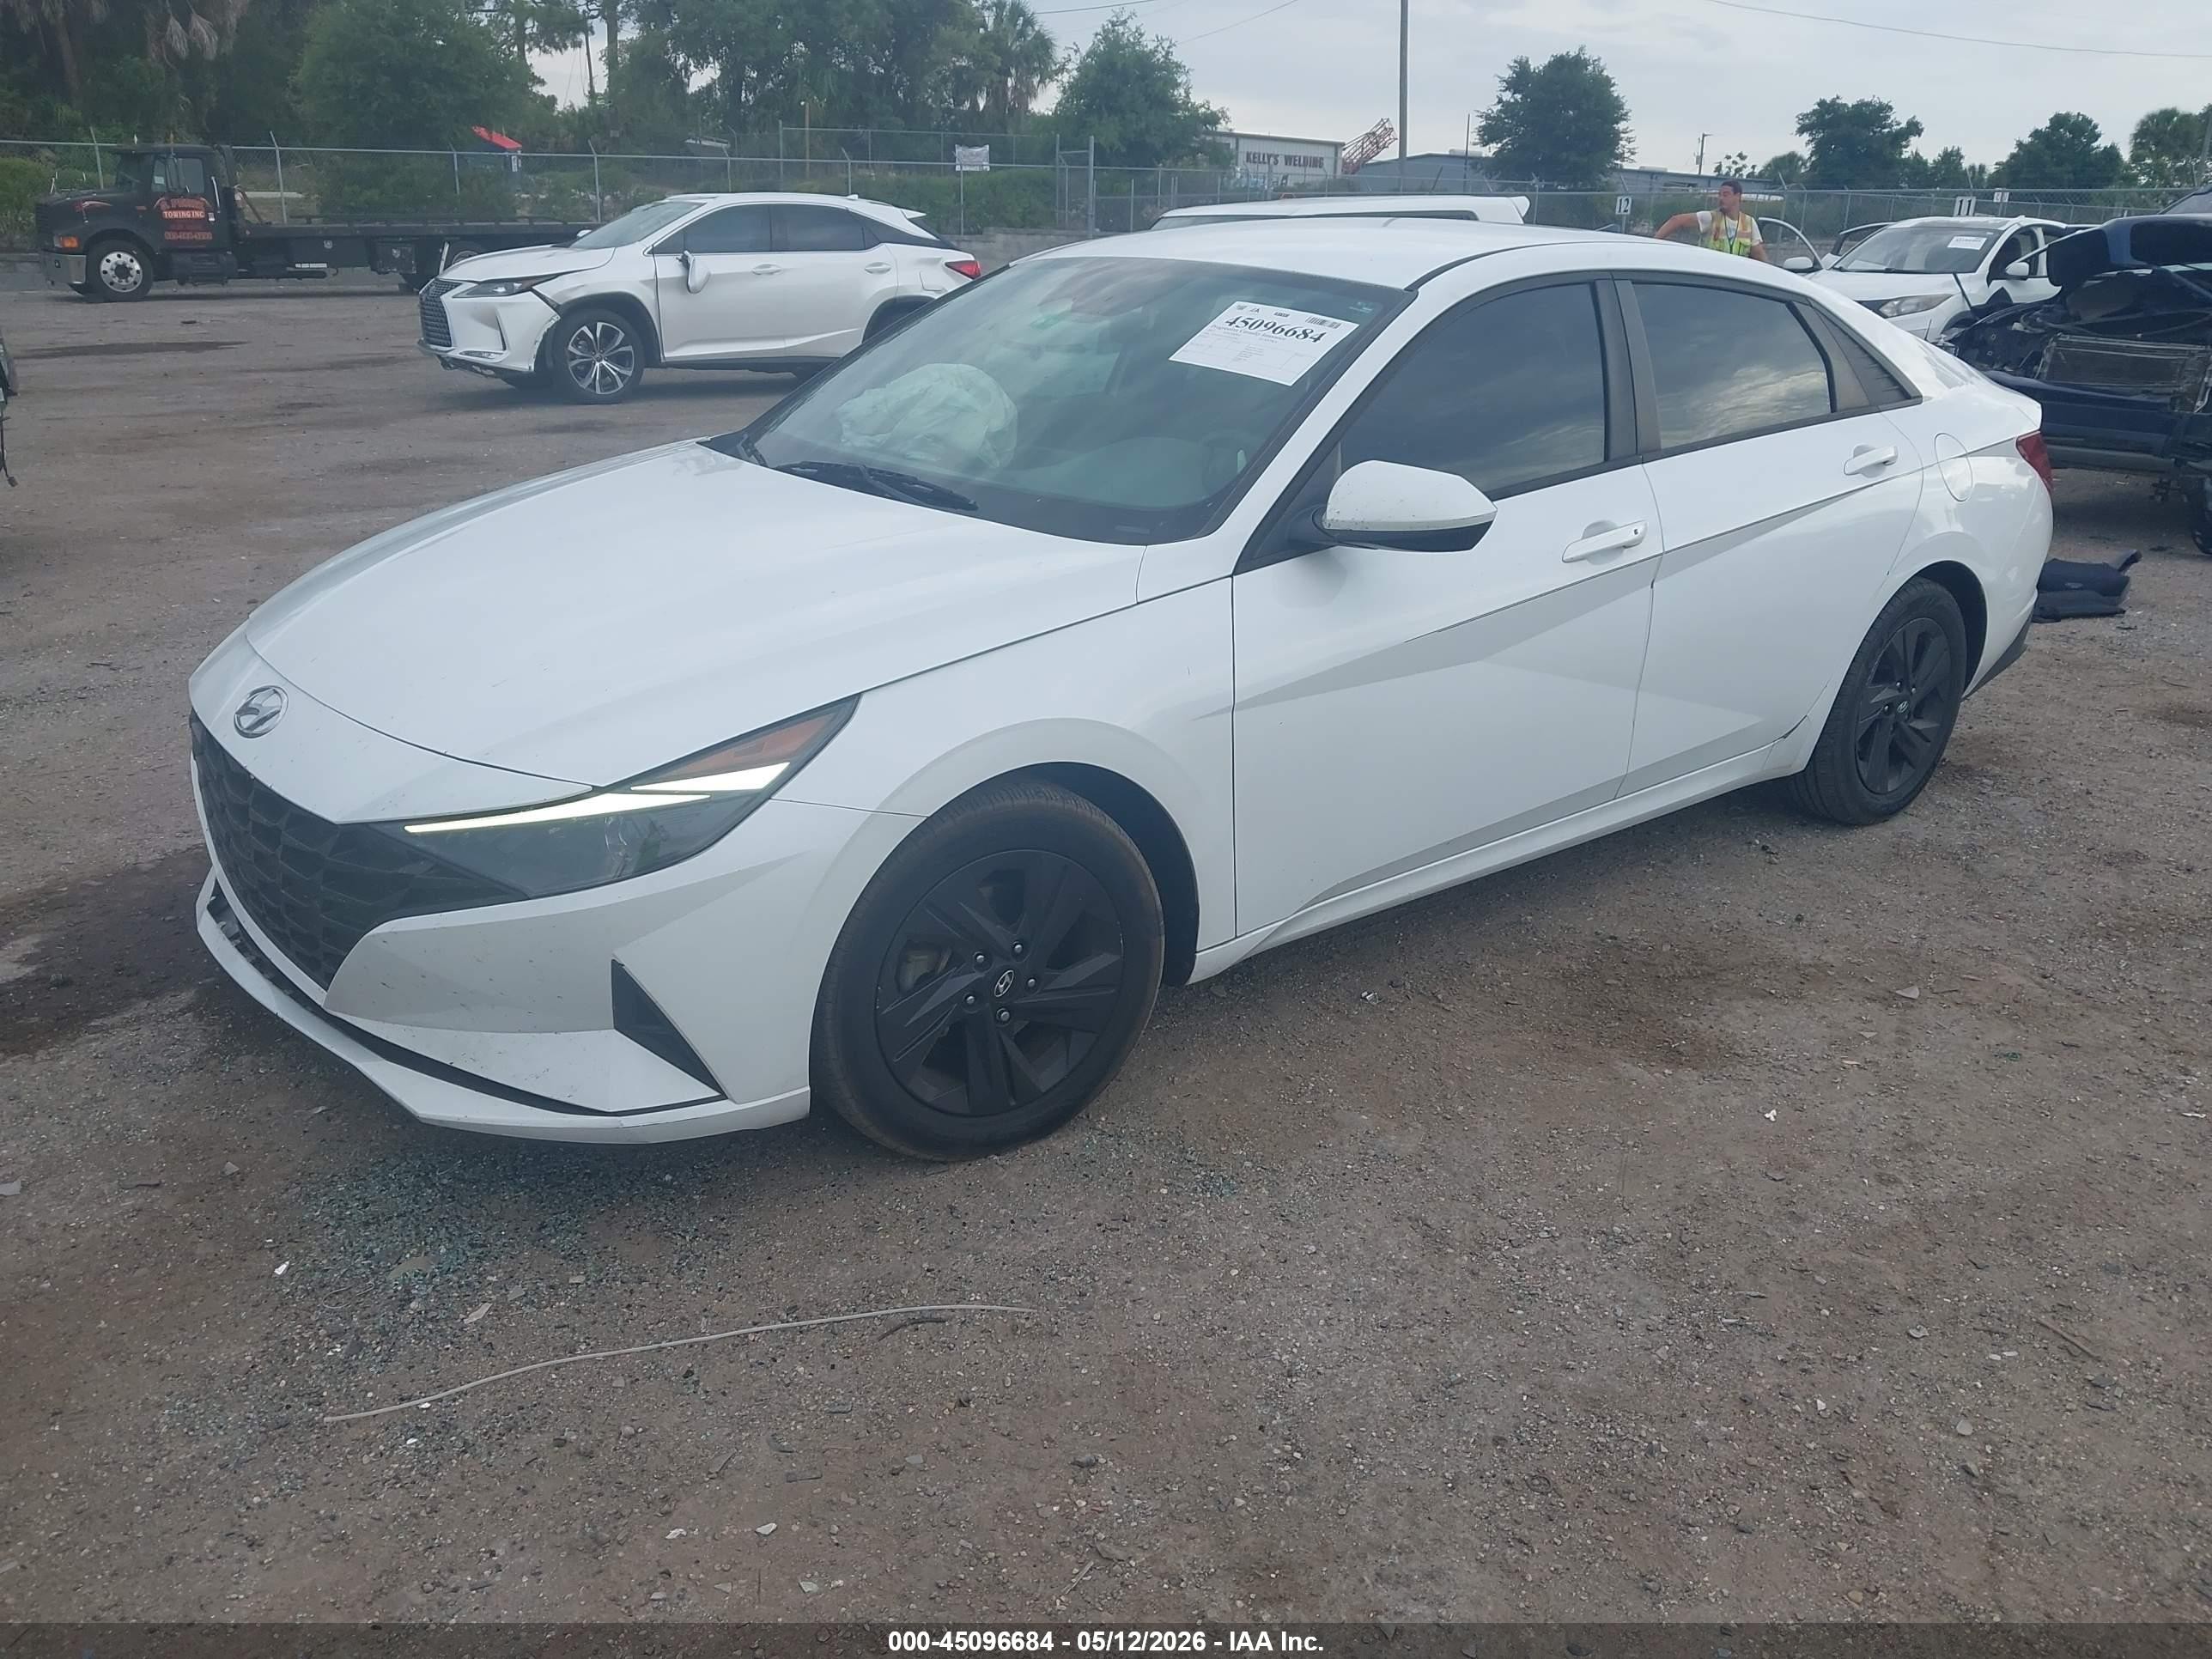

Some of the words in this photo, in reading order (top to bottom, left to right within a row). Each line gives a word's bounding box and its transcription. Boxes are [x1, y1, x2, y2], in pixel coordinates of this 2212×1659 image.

[1245, 151, 1279, 166] KELLY'S
[1284, 155, 1324, 168] WELDING
[1618, 198, 1630, 213] 12
[1957, 198, 1972, 216] 11
[163, 210, 191, 219] TOWING
[1224, 315, 1328, 343] 45096684
